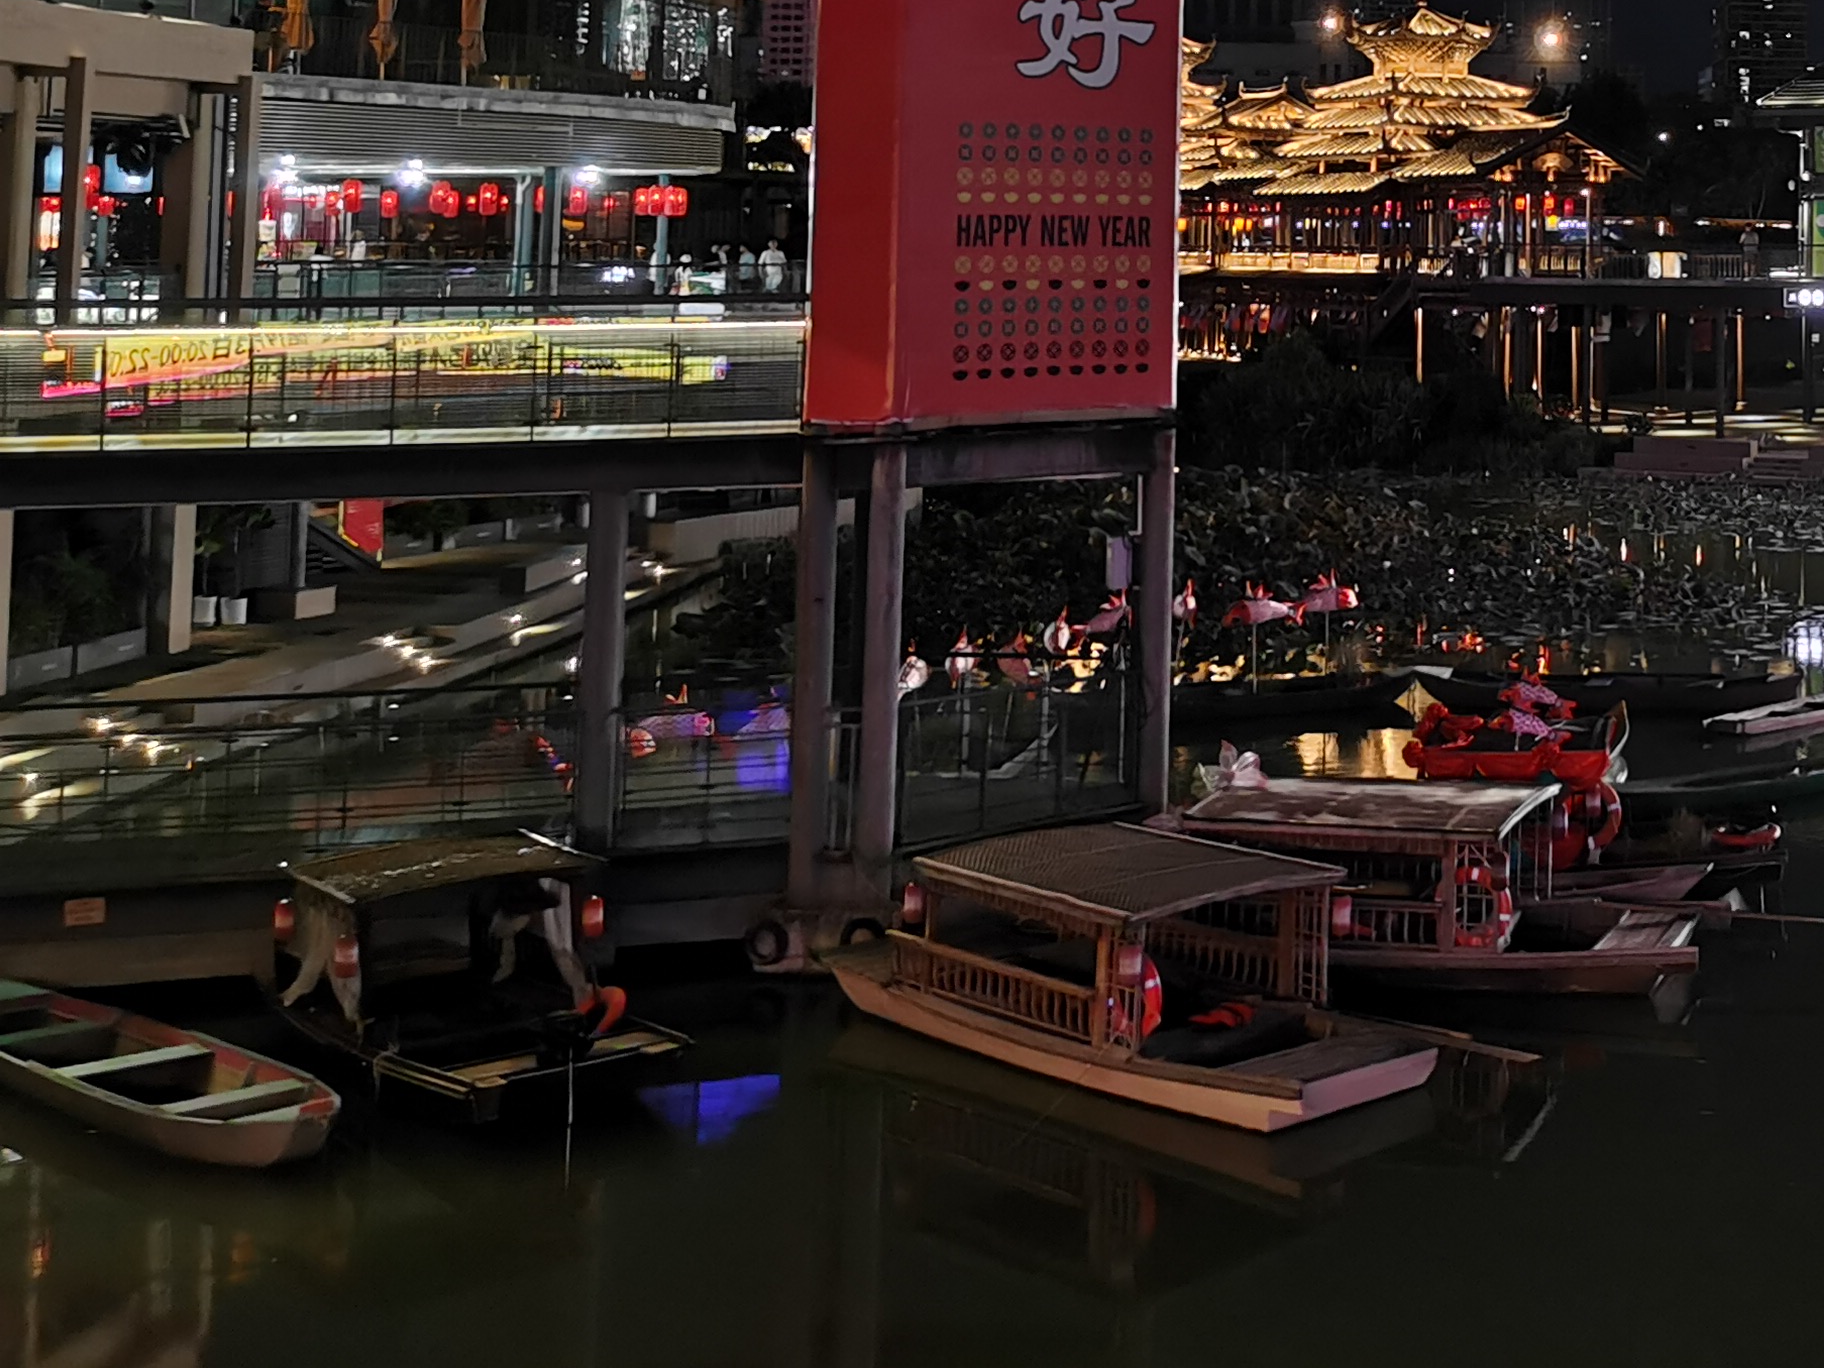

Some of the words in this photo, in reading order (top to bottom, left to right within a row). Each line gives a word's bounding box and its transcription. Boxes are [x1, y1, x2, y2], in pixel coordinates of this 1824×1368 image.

[957, 214, 1031, 247] HAPPY
[1041, 214, 1090, 247] NEW
[1098, 215, 1151, 248] YEAR
